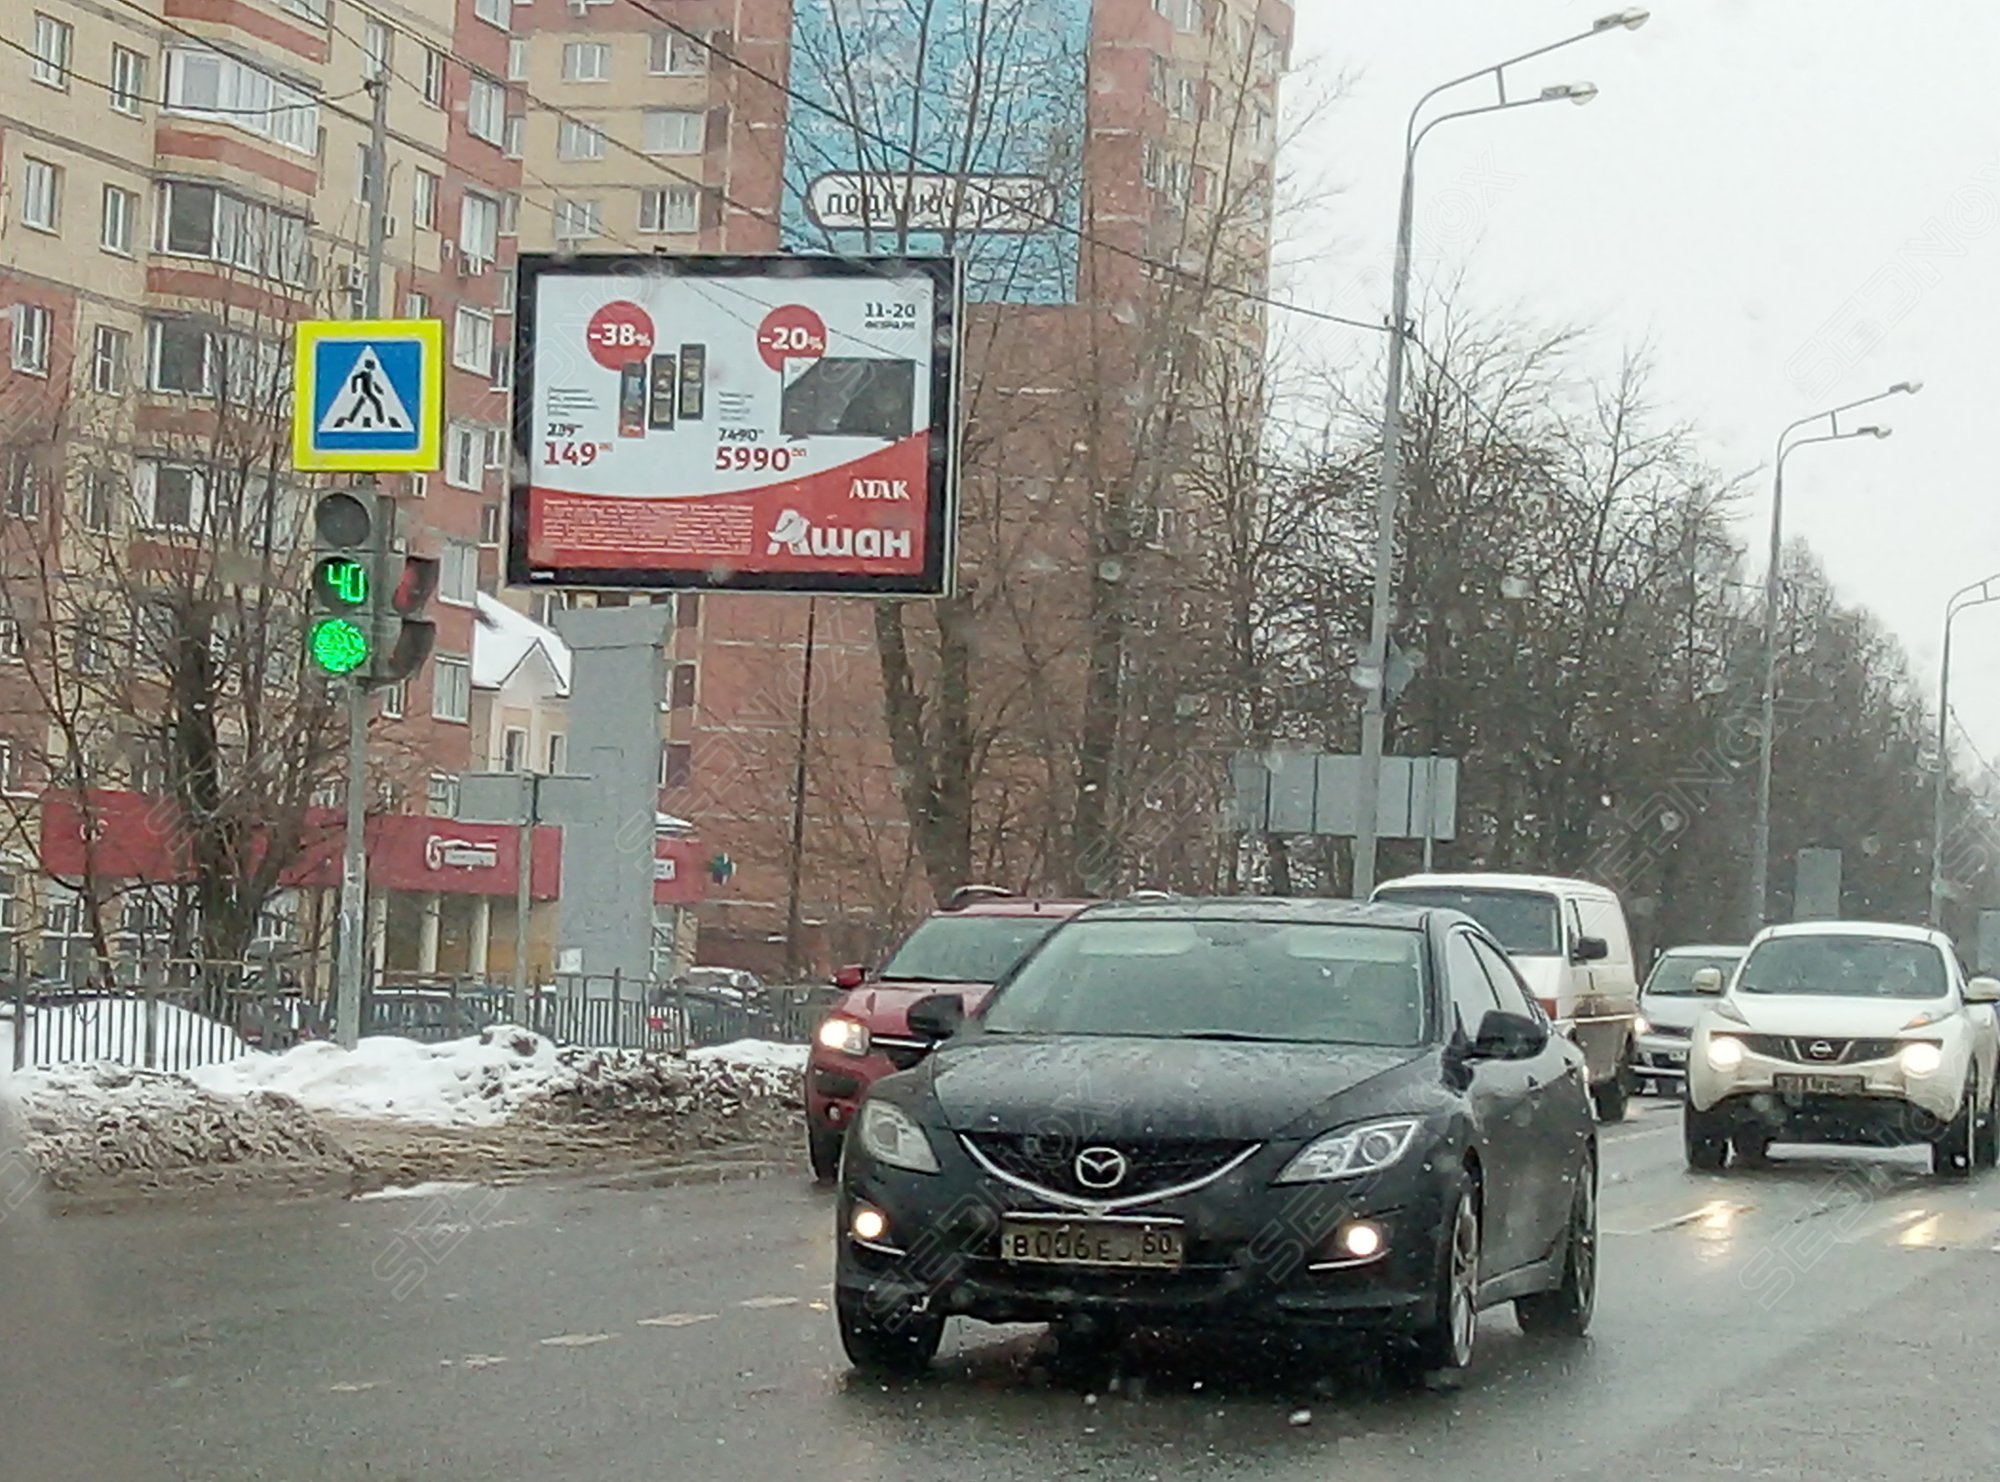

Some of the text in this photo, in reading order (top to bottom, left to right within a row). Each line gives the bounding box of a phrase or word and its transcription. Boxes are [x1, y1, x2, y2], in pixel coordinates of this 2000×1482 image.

[864, 301, 916, 318] 11-20
[589, 321, 652, 347] -38%
[759, 326, 824, 351] -20%
[543, 441, 597, 466] 149
[715, 446, 791, 471] 5990
[766, 508, 911, 559] Ашан
[327, 563, 365, 604] 40
